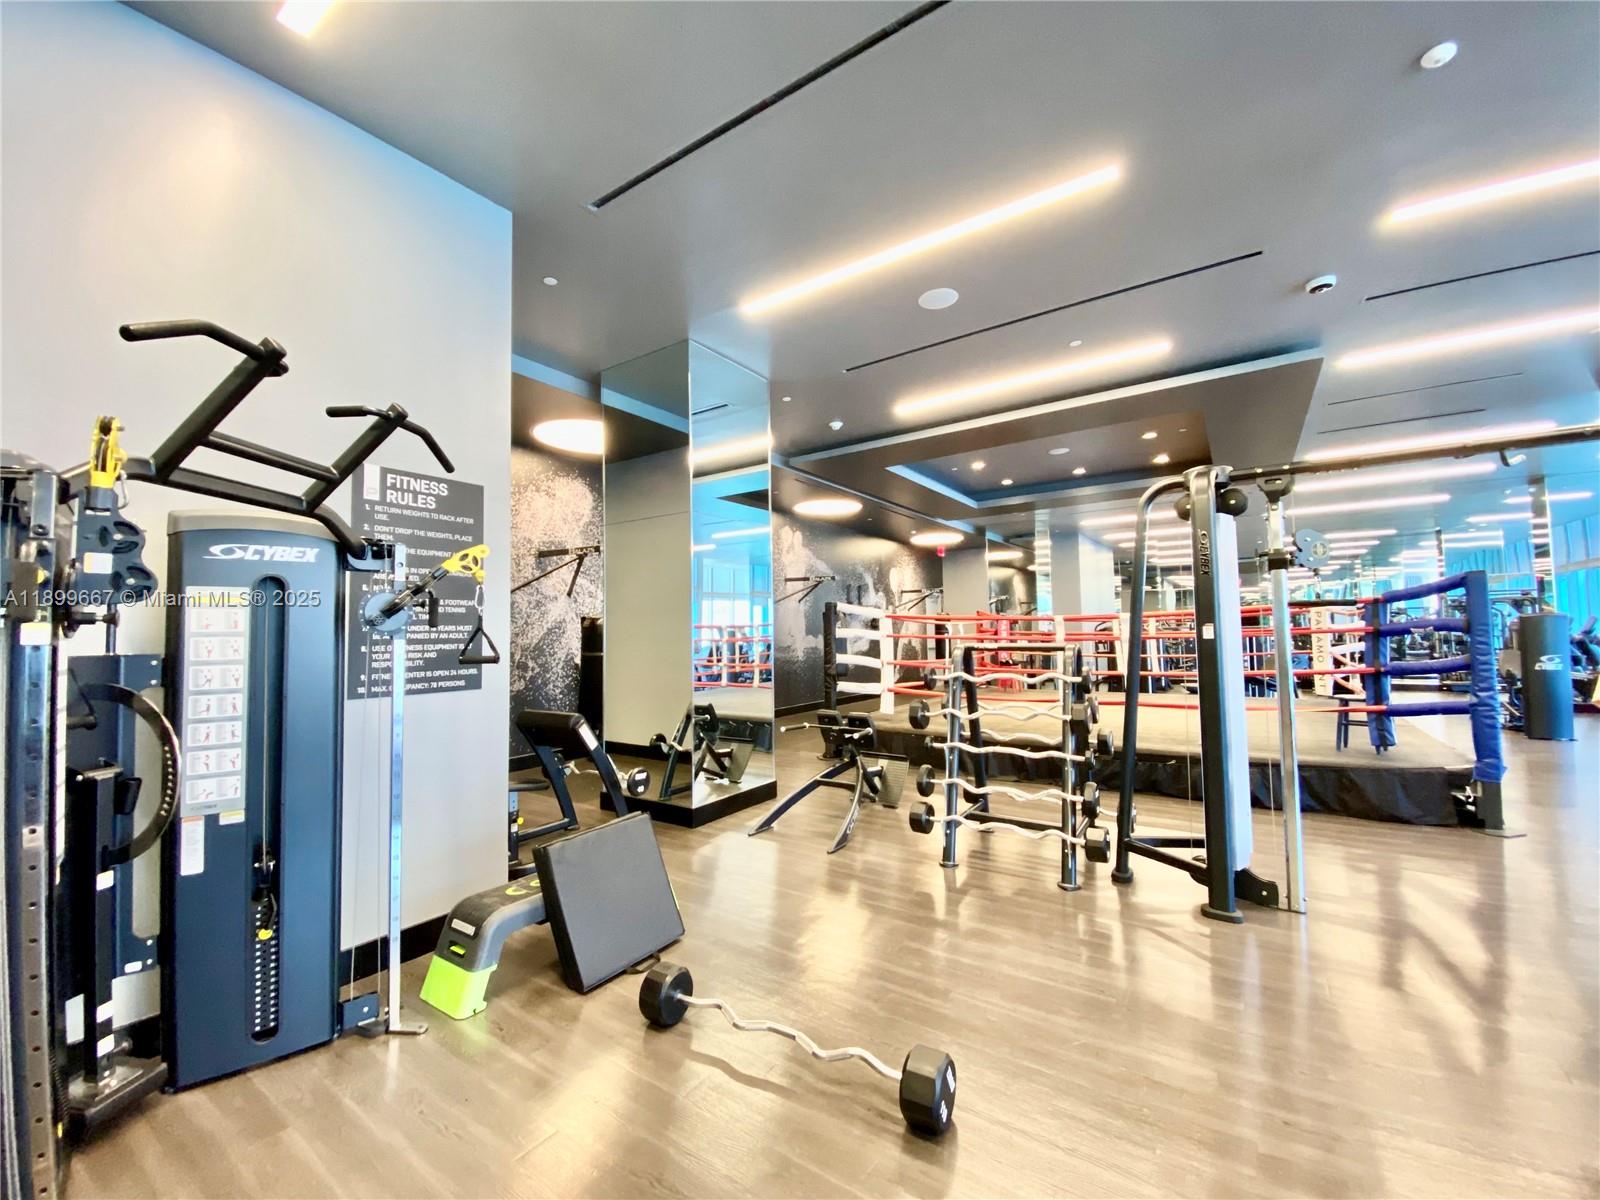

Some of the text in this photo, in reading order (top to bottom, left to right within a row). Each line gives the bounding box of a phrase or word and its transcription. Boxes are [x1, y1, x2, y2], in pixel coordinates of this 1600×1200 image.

[386, 473, 448, 496] FITNESS
[386, 489, 436, 509] RULES
[374, 504, 402, 515] RETURN
[402, 509, 430, 519] WEIGHTS
[431, 512, 438, 520] TO
[439, 513, 455, 521] RACK
[456, 515, 474, 524] AFTER
[374, 513, 389, 521] USE.
[363, 523, 370, 531] 2.
[374, 524, 394, 533] DON'T
[395, 526, 413, 536] DROP
[454, 533, 473, 542] PLACE
[243, 544, 320, 562] CYBEX
[416, 548, 452, 558] EQUIPMENT
[1200, 544, 1210, 576] CYBEX
[371, 653, 391, 661] YOUR
[438, 679, 466, 688] PERSONS
